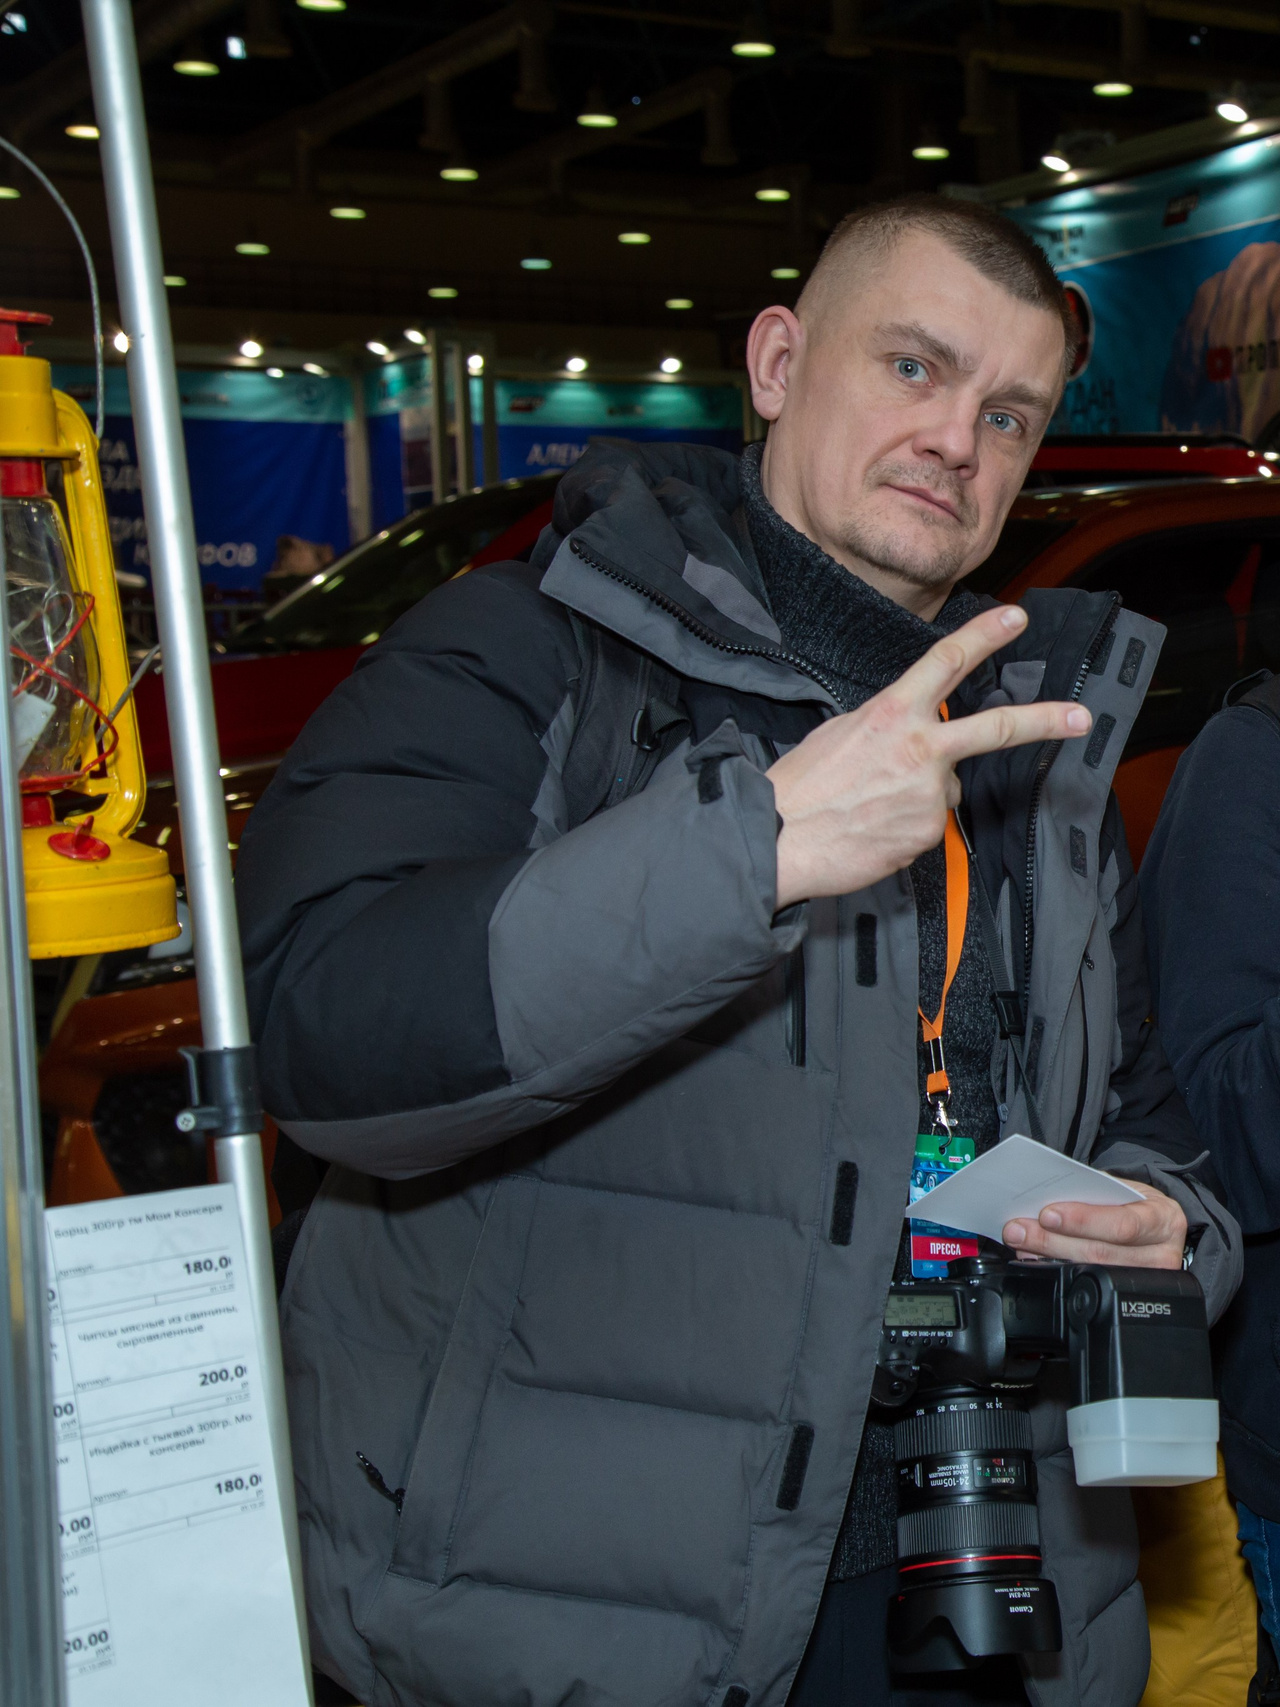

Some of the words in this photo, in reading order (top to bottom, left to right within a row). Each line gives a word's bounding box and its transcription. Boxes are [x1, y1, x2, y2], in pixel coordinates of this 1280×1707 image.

[930, 1242, 961, 1255] ПРЕССА
[78, 1328, 117, 1343] Чипсы
[120, 1318, 165, 1334] мясные
[116, 1324, 204, 1350] сыровяленные
[937, 1405, 946, 1413] 85
[89, 1438, 140, 1458] Индейка
[152, 1425, 194, 1443] тыквой
[149, 1437, 205, 1457] консервы
[930, 1476, 969, 1487] 24-105mm
[991, 1477, 1015, 1485] Canon
[1009, 1605, 1034, 1613] Canon
